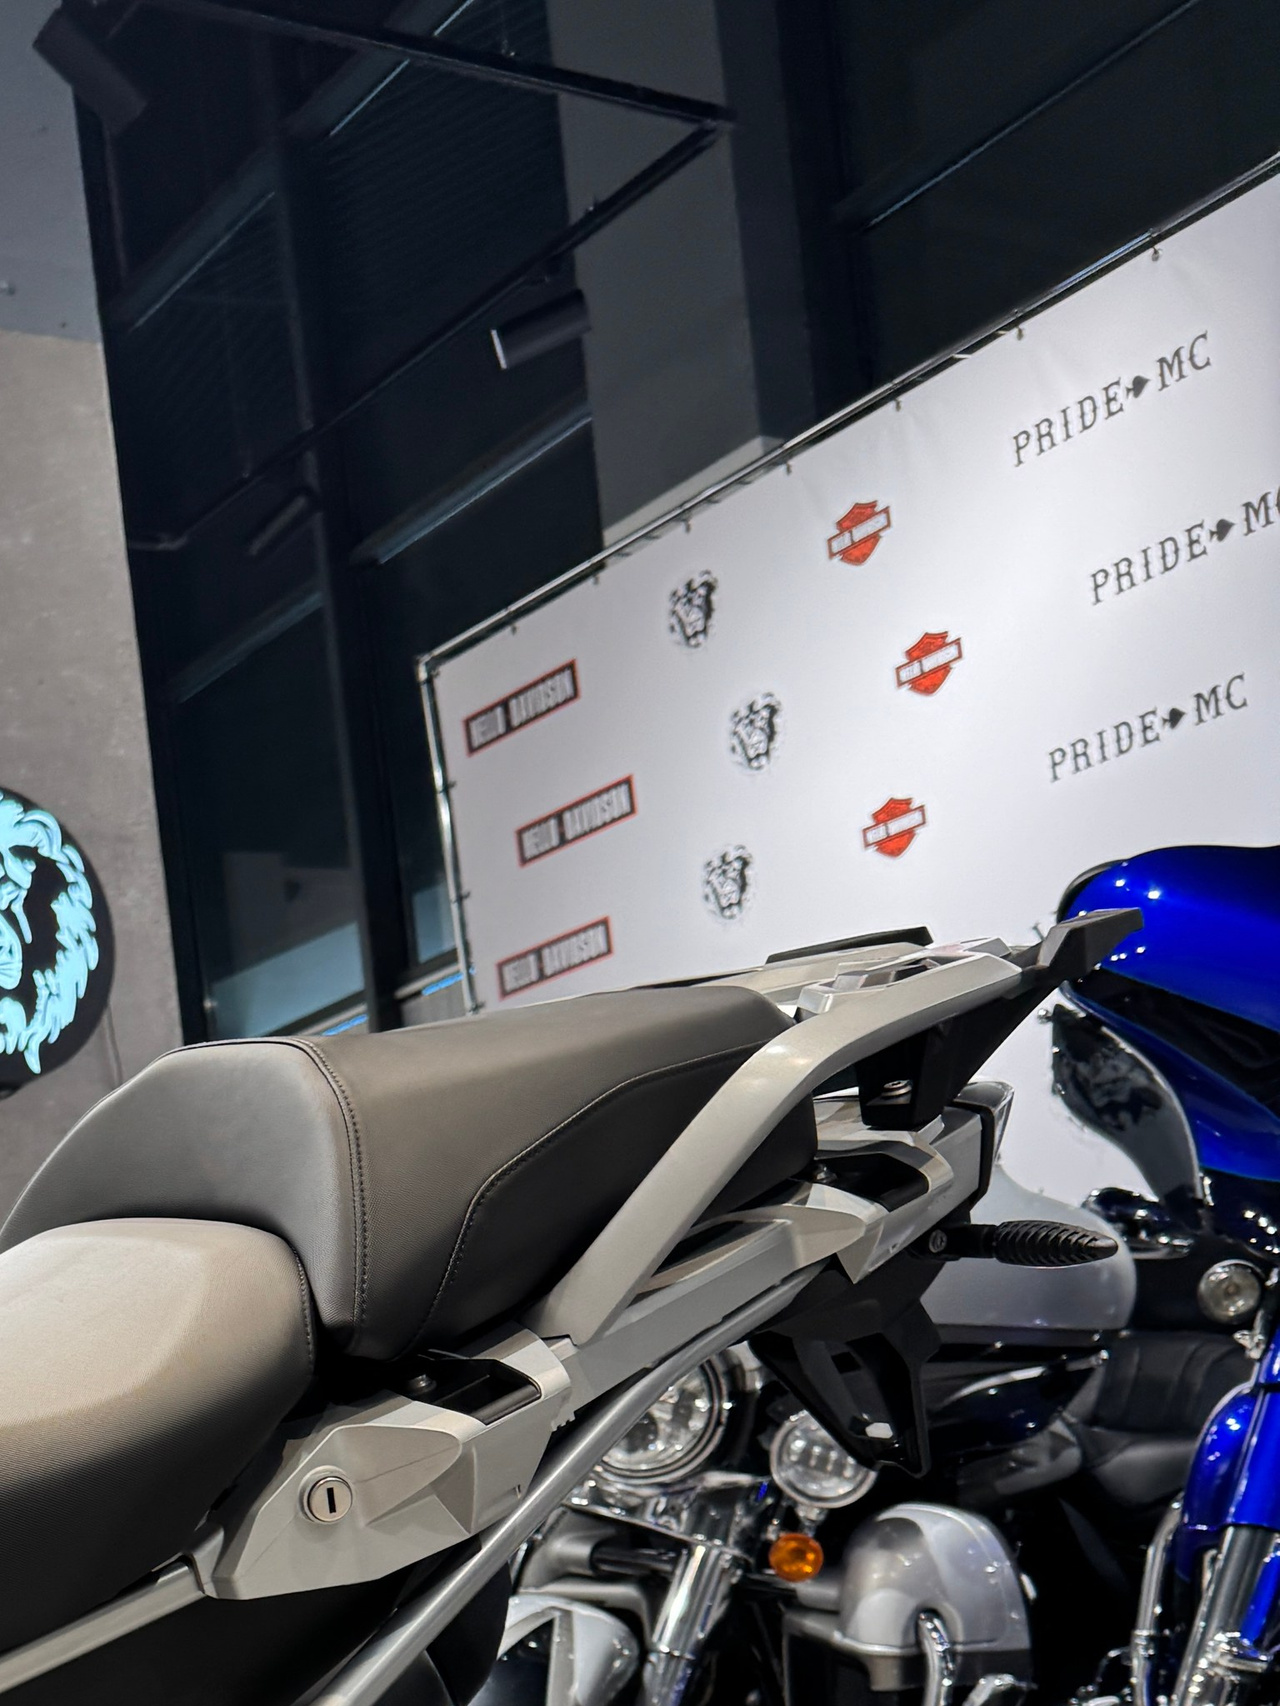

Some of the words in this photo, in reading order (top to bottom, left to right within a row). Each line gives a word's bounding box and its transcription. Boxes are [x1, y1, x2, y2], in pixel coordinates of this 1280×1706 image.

[1012, 379, 1124, 467] PRIDE
[1156, 332, 1211, 391] MC
[1089, 521, 1208, 605] PRIDE
[1242, 489, 1280, 536] M
[1048, 708, 1160, 782] PRIDE
[1193, 674, 1247, 726] MC
